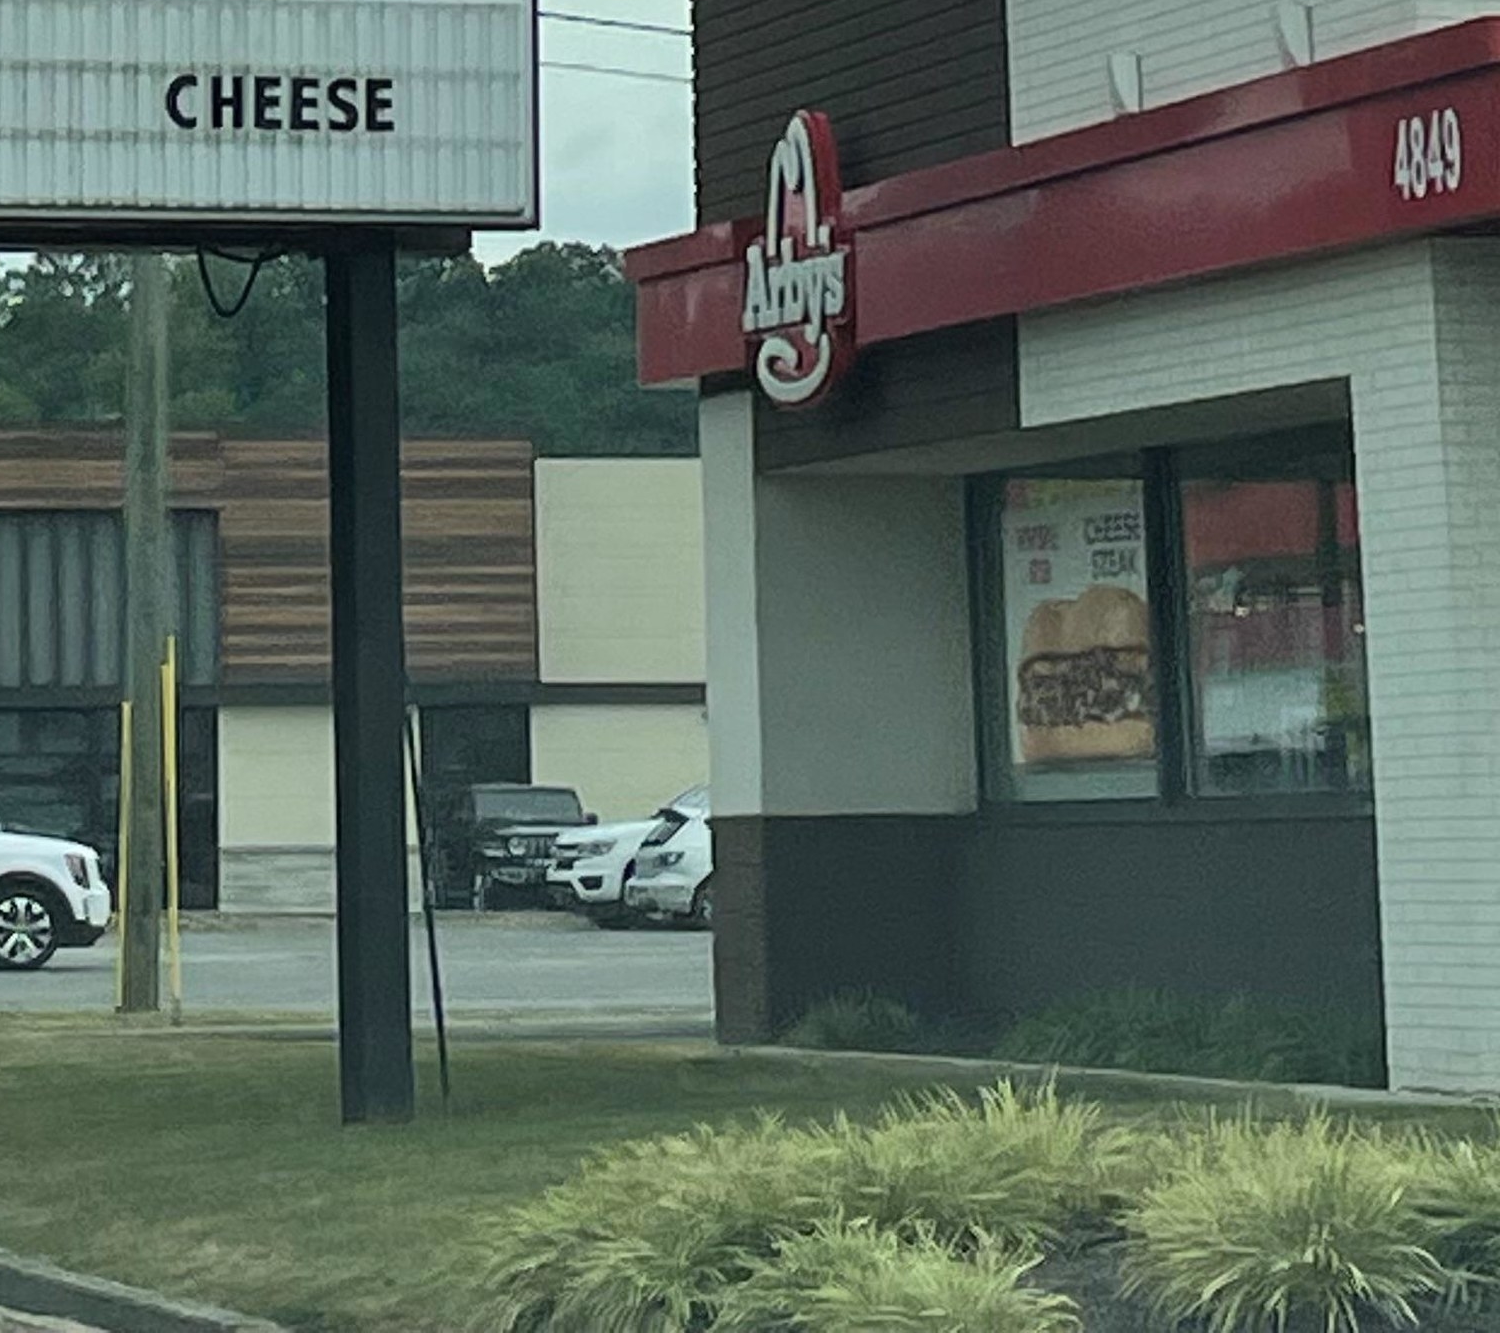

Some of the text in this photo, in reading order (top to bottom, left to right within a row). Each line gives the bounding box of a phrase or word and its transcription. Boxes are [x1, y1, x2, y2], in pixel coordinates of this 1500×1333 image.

[166, 75, 395, 132] CHEESE
[1394, 107, 1461, 201] 4849
[742, 224, 845, 345] Arby's
